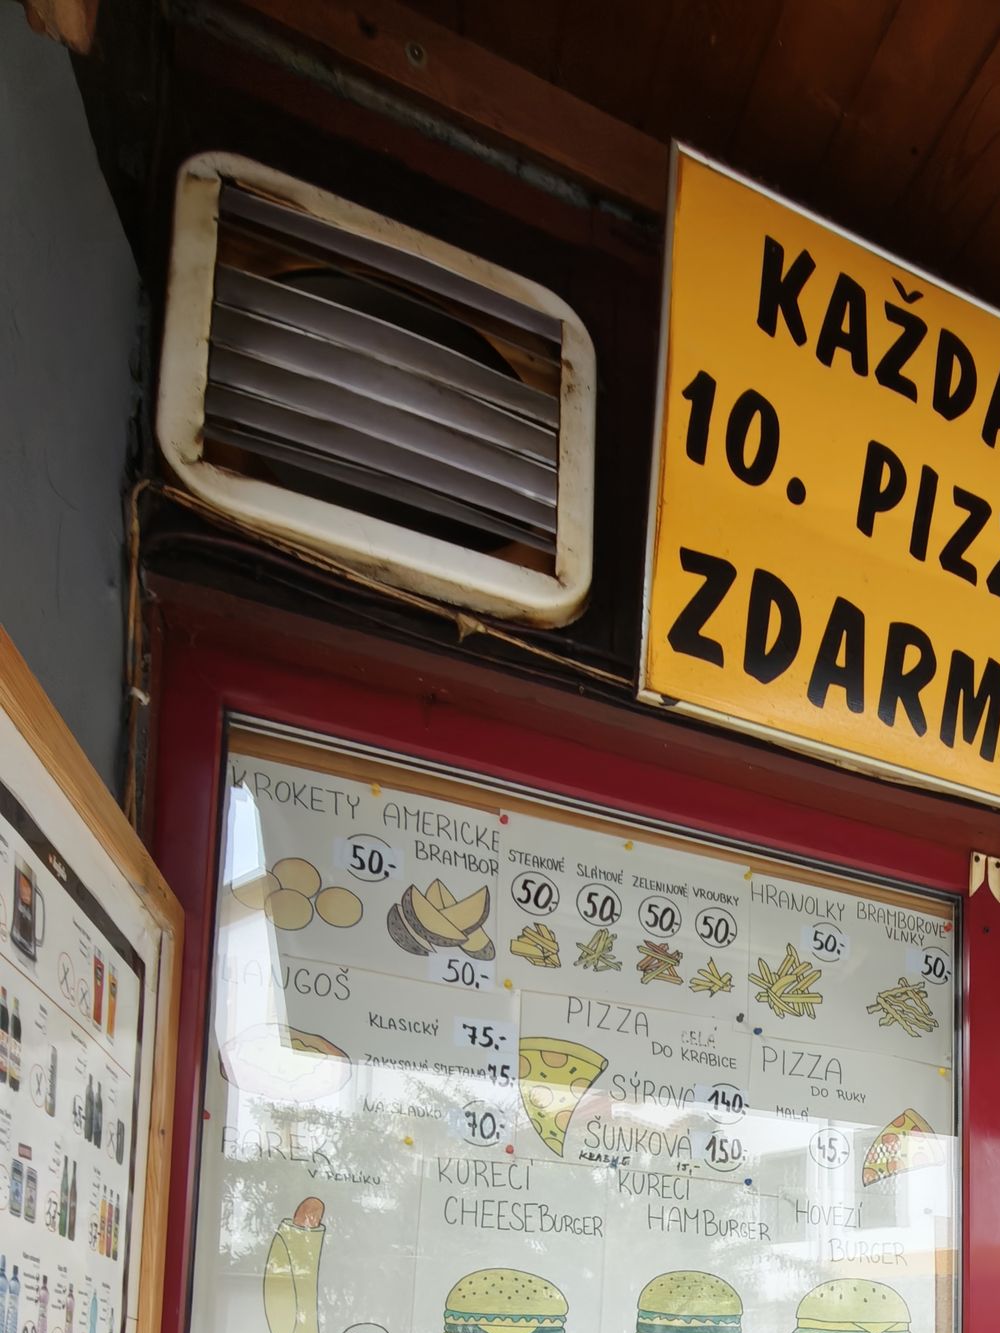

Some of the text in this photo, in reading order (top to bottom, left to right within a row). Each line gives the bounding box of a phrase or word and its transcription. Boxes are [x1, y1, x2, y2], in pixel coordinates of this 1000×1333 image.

[682, 370, 806, 505] 10.
[232, 765, 360, 820] KROKETY
[508, 849, 565, 873] STEAKOVÉ
[577, 863, 624, 885] SLÁMOVÉ
[632, 875, 688, 898] ZELENINOVÉ
[692, 887, 739, 907] VROUBKY
[751, 880, 845, 922] HRANOLKY
[885, 926, 925, 946] VLNKY
[369, 1012, 439, 1037] KLASICKÝ
[567, 997, 649, 1037] PIZZA
[652, 1041, 738, 1069] DO KRABICE
[762, 1046, 843, 1084] PIZZA
[610, 1071, 695, 1109] SÝROVÁ
[811, 1086, 867, 1104] DO RUKY
[776, 1105, 809, 1120] MALÁ
[584, 1115, 693, 1159] ŠUNKOVÁ
[309, 1169, 318, 1179] V
[444, 1195, 603, 1238] CHEESEBURGER
[648, 1205, 771, 1242] HAMBURGER
[829, 1238, 907, 1266] BURGER
